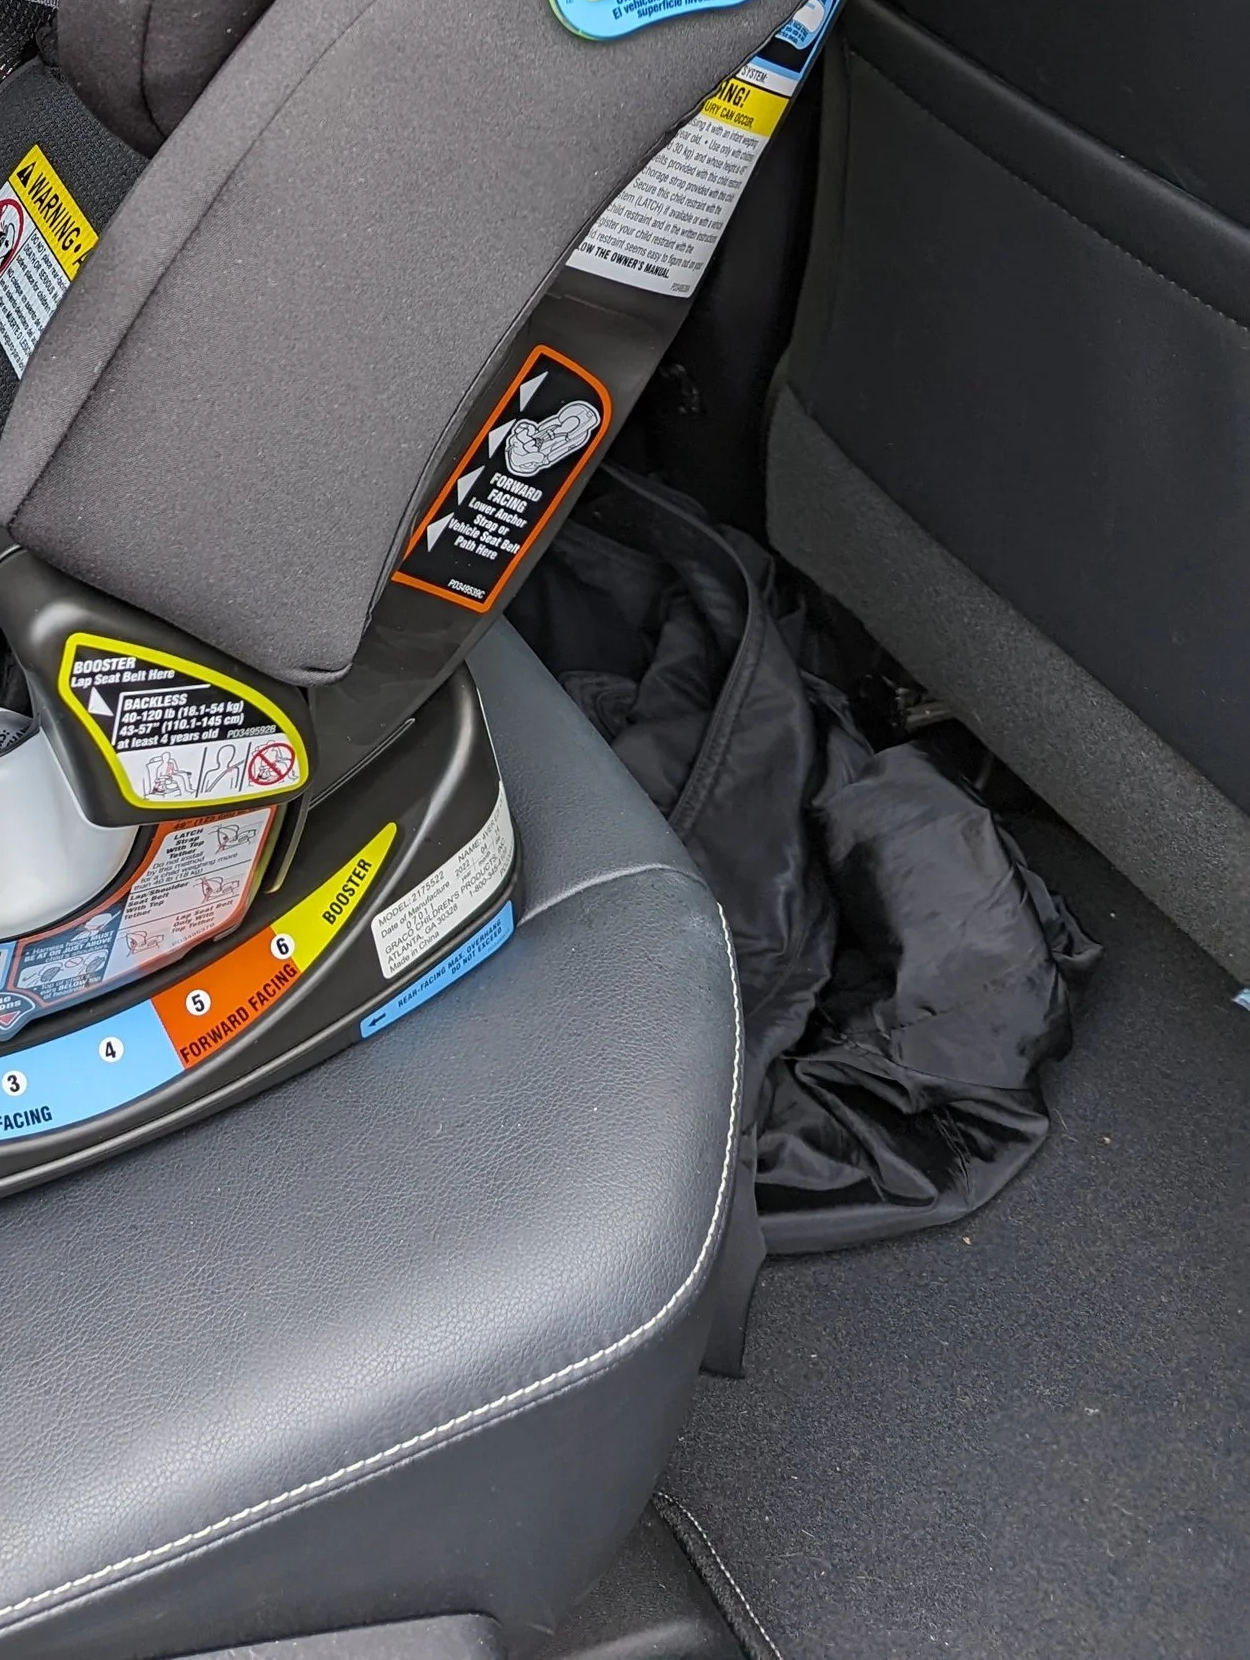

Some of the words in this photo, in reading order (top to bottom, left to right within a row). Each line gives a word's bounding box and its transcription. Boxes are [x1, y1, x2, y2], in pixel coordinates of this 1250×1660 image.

[613, 8, 622, 20] El
[720, 106, 734, 120] CAN
[633, 178, 656, 195] Secure
[658, 185, 670, 198] this
[670, 188, 686, 205] child
[28, 172, 80, 252] WARNING
[596, 247, 610, 260] THE
[611, 252, 645, 271] OWNER'S
[490, 472, 543, 502] FORWARD
[468, 497, 496, 516] Lower
[495, 507, 527, 528] Anchor
[488, 488, 527, 513] FACING
[449, 518, 480, 538] Vehicle
[480, 531, 501, 547] Seat
[500, 539, 520, 554] Belt
[473, 514, 498, 533] Strap
[498, 525, 510, 536] or
[454, 535, 476, 551] Path
[475, 543, 498, 560] Here
[73, 657, 136, 674] BOOSTER
[70, 677, 91, 689] Lap
[94, 673, 120, 685] Seat
[122, 671, 147, 683] Belt
[149, 669, 175, 681] Here
[122, 709, 162, 724] 40-120
[164, 707, 175, 719] lb
[178, 702, 224, 719] (18.1-54
[226, 700, 244, 714] kg)
[124, 693, 188, 711] BACKLESS
[162, 714, 222, 734] (110.1-145
[224, 713, 244, 726] cm)
[117, 740, 129, 750] at
[131, 735, 159, 748] least
[160, 734, 168, 744] 4
[169, 731, 200, 746] years
[201, 729, 219, 740] old
[174, 828, 204, 840] LATCH
[176, 836, 200, 845] Strap
[166, 843, 187, 854] With
[189, 840, 205, 849] Top
[169, 848, 197, 859] Tether
[322, 858, 372, 925] BOOSTER
[381, 922, 398, 939] Date
[399, 915, 407, 926] of
[407, 881, 450, 920] Manufacture
[455, 860, 470, 877] 2022
[385, 928, 415, 955] GRACO
[415, 892, 460, 932] CHILDREN'S
[425, 923, 437, 934] GA
[437, 904, 459, 928] 30328
[277, 938, 290, 955] 6
[389, 954, 411, 973] Made
[419, 931, 440, 953] China
[451, 964, 461, 974] DO
[463, 952, 476, 965] NOT
[477, 926, 503, 954] EXCEED
[398, 968, 446, 1007] REAR-FACING
[447, 954, 464, 969] MAX.
[466, 918, 502, 953] OVERHANG
[180, 1004, 250, 1063] FORWARD
[249, 963, 298, 1011] FACING
[192, 994, 204, 1012] 5
[104, 1042, 116, 1058] 4
[7, 1075, 20, 1092] 3
